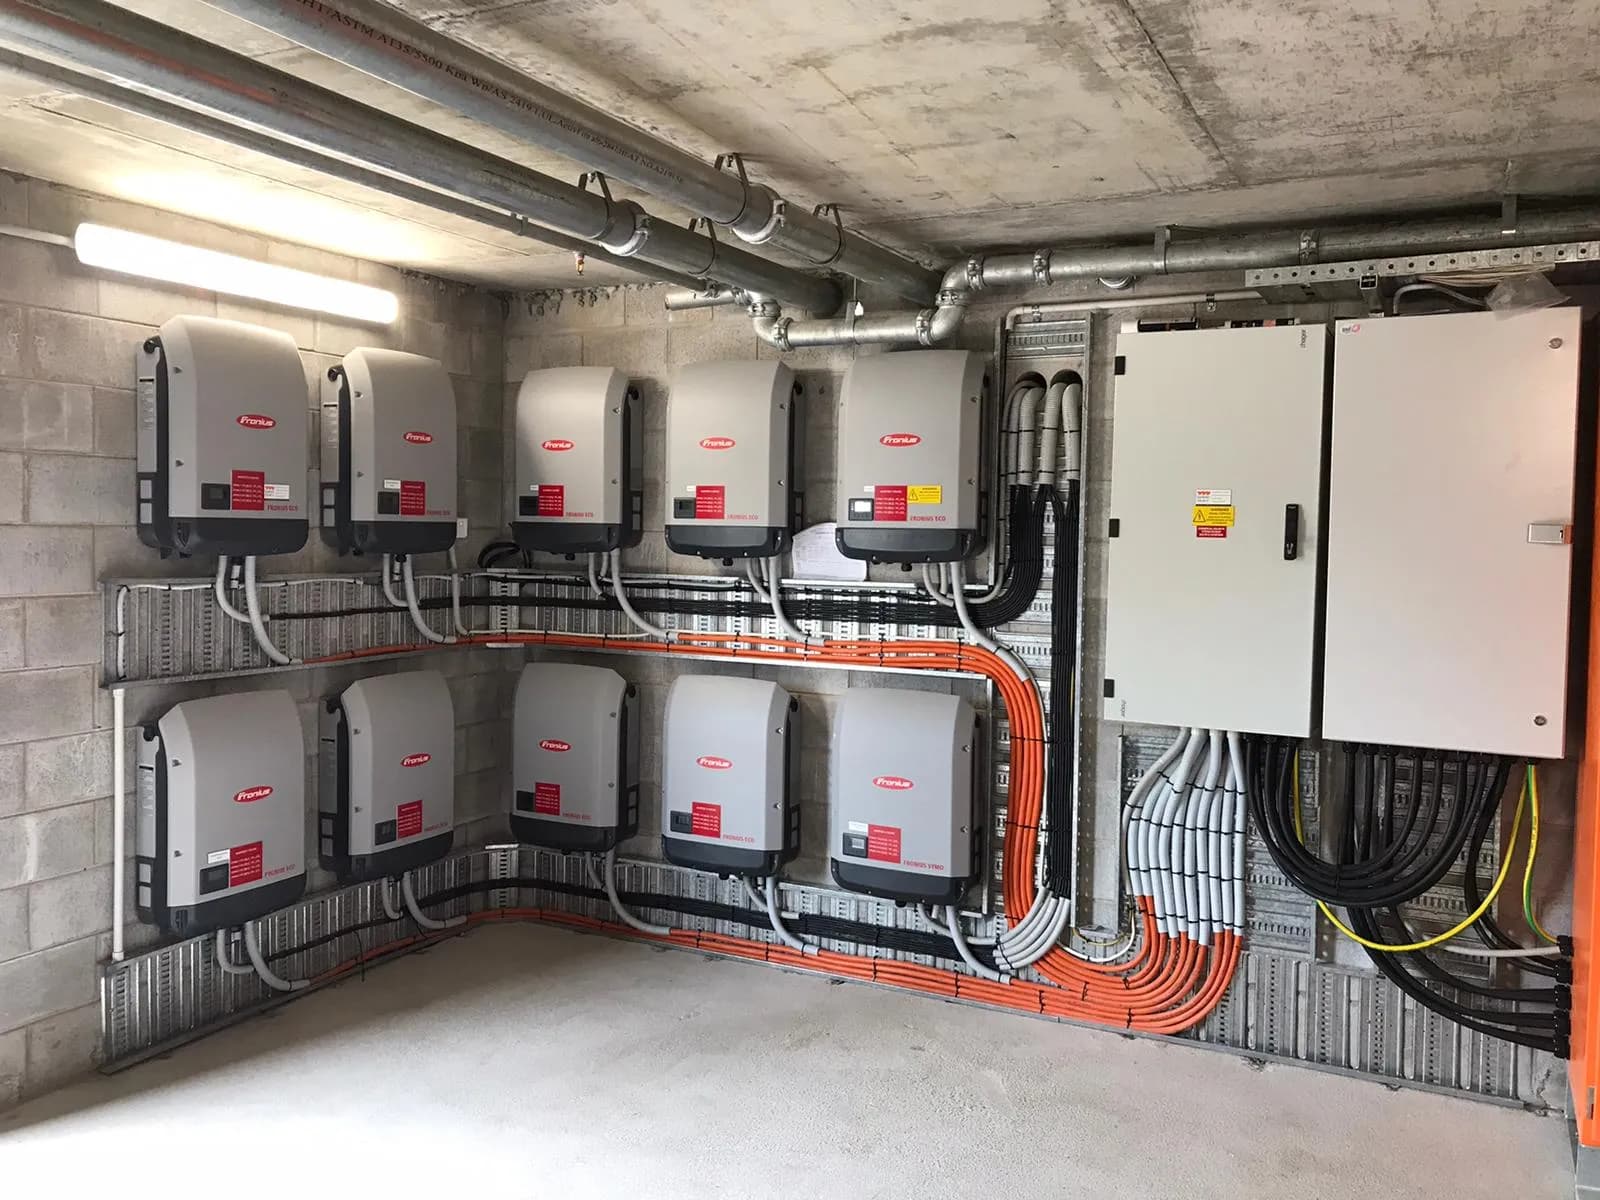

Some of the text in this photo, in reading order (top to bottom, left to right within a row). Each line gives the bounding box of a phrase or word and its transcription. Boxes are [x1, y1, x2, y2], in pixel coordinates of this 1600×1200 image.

[297, 0, 374, 37] HT/ASTM
[239, 415, 275, 427] Fronius
[702, 439, 733, 447] Fronius
[883, 435, 918, 444] Fronius
[543, 441, 573, 449] Fronius
[541, 740, 569, 750] Fronius
[699, 758, 731, 767] Fronius
[876, 777, 912, 788] Fronius
[237, 787, 271, 801] Fronius
